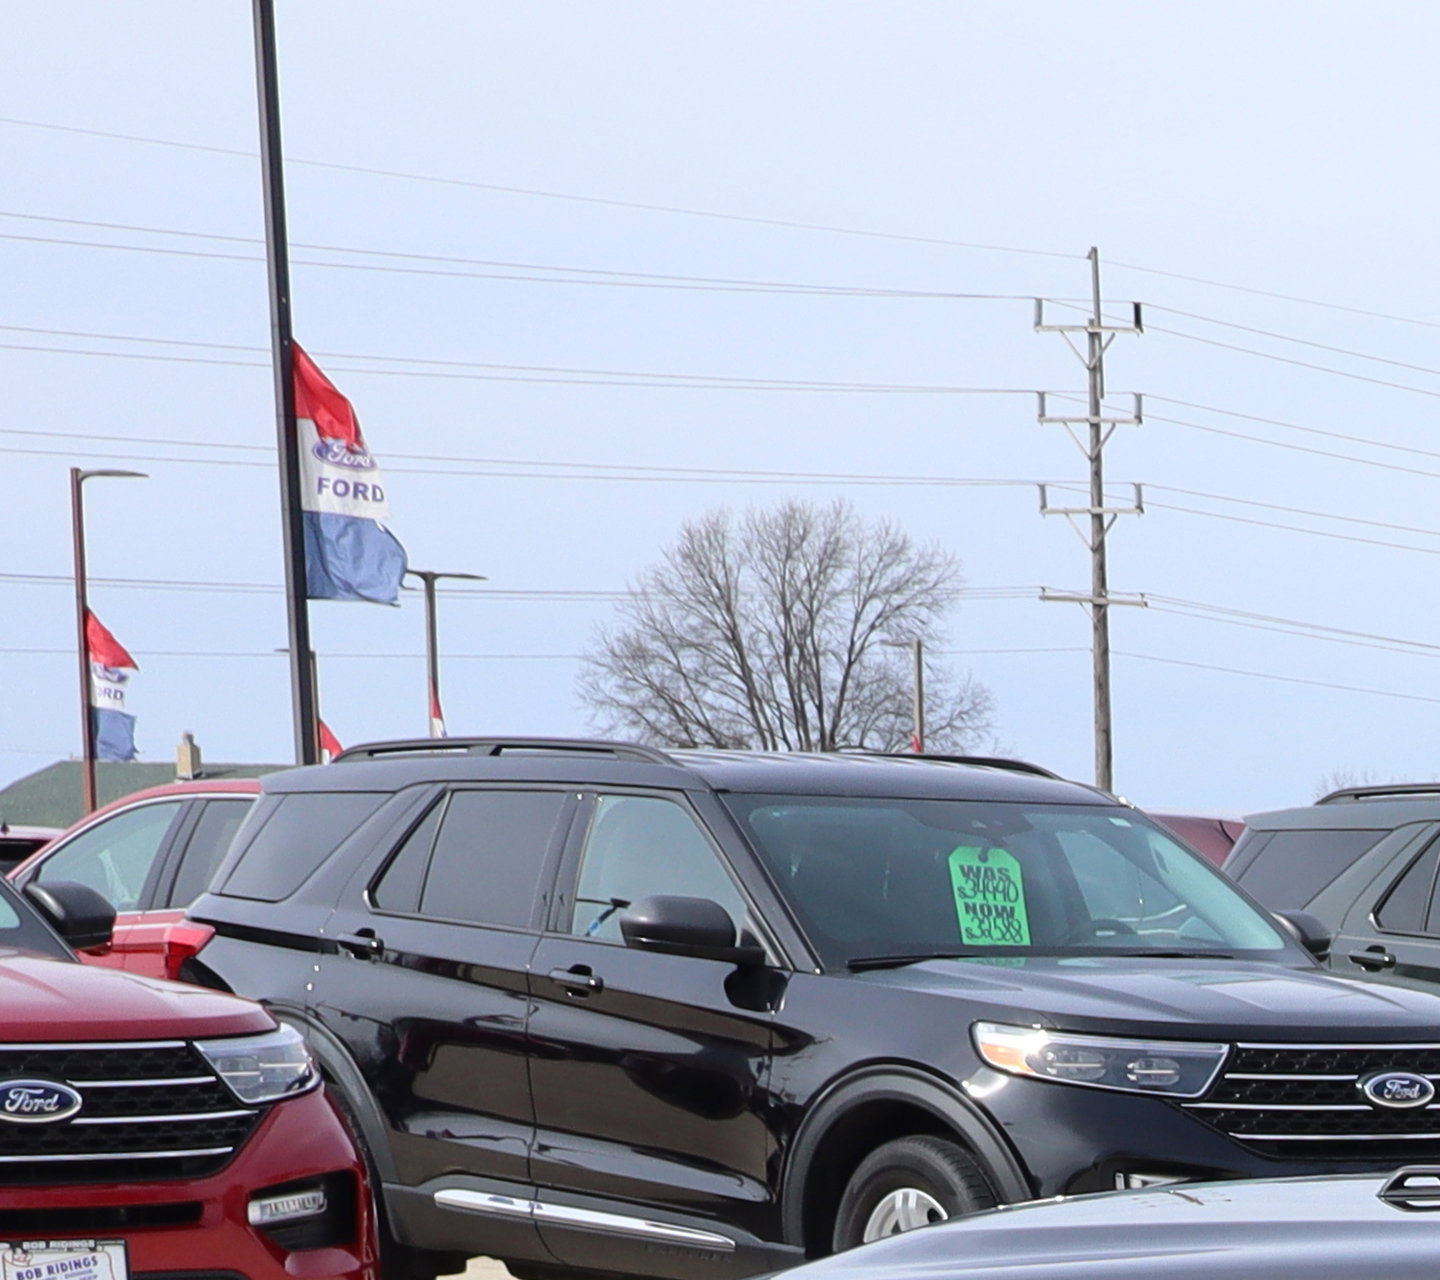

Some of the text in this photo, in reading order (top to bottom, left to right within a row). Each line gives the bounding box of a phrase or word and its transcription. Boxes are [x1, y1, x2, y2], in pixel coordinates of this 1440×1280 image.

[317, 477, 385, 503] FORD
[959, 864, 1011, 881] WAS
[964, 902, 1015, 920] NOW
[1383, 1079, 1420, 1099] Ford
[4, 1087, 60, 1112] Ford
[23, 1241, 46, 1249] BOB
[46, 1255, 99, 1276] RIDINGS
